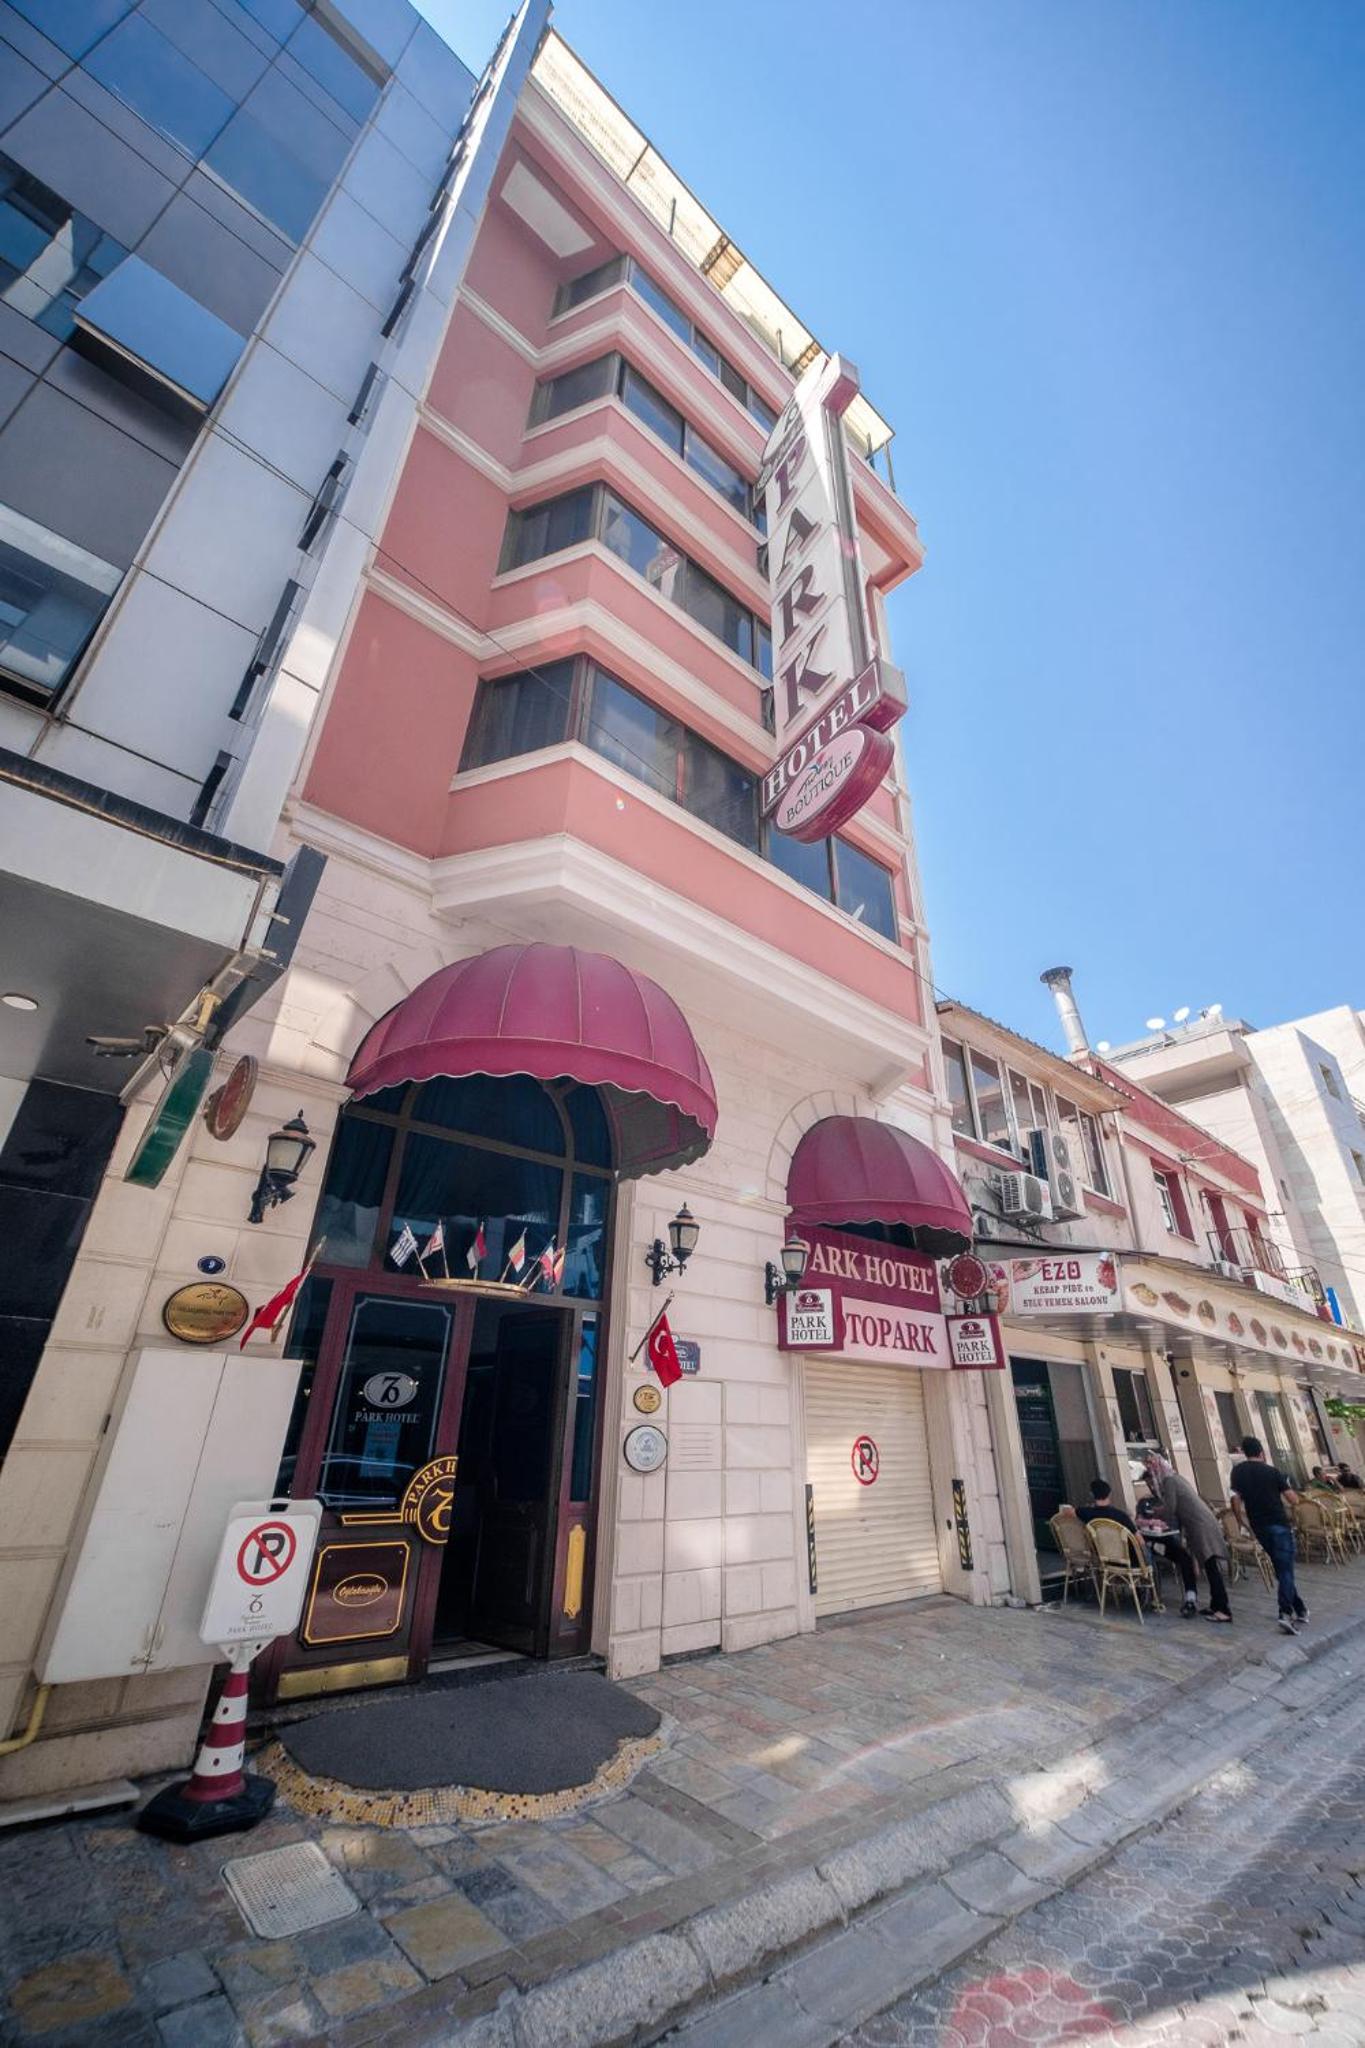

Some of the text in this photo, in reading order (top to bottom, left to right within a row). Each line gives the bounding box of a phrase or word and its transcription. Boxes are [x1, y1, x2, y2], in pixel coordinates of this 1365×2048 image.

[774, 434, 833, 728] PARK
[766, 681, 872, 802] HOTEL
[786, 751, 853, 822] BOUTIQUE
[863, 1254, 934, 1296] HOTEL
[1041, 1260, 1081, 1281] EZO
[791, 1315, 826, 1329] PARK
[791, 1329, 832, 1341] HOTEL
[956, 1339, 990, 1352] PARK
[958, 1351, 996, 1363] HOTEL
[354, 1411, 420, 1424] PARK HOTEL
[407, 1462, 444, 1503] PARK
